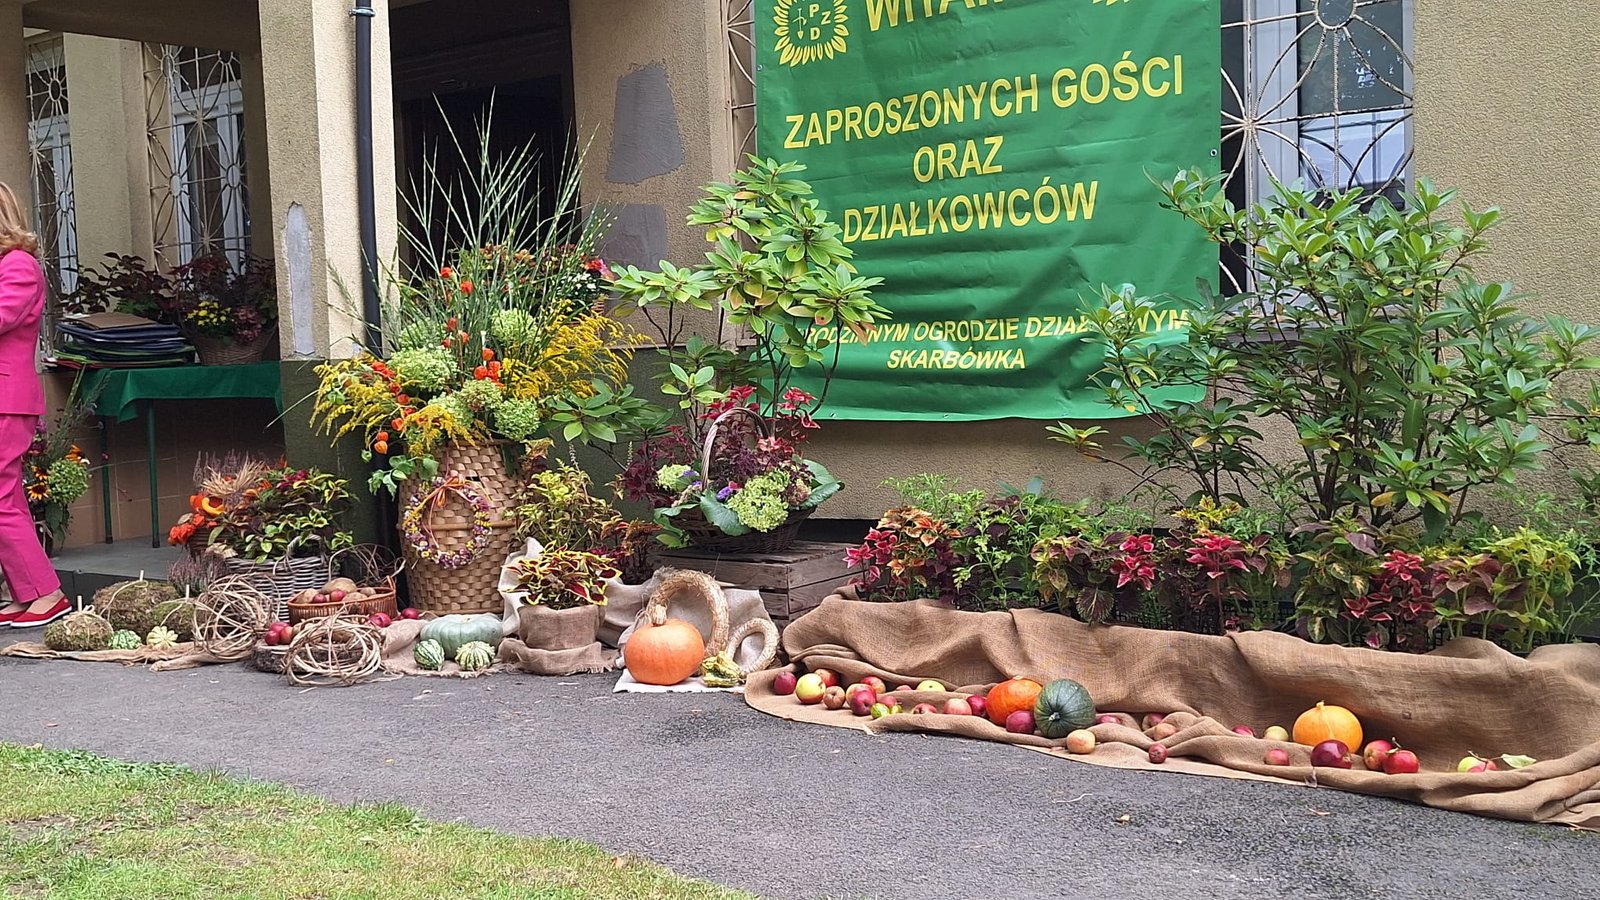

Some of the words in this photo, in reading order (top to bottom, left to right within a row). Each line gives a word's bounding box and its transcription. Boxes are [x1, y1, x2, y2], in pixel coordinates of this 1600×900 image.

[784, 73, 1038, 149] ZAPROSZONYCH
[1051, 50, 1184, 109] GOŚCI
[912, 136, 1004, 183] ORAZ
[842, 176, 1099, 244] DZIAŁKOWCÓW
[806, 322, 910, 344] RODZINYM
[913, 317, 1020, 342] OGRODZIE
[886, 346, 1026, 370] SKARBÓWKA
